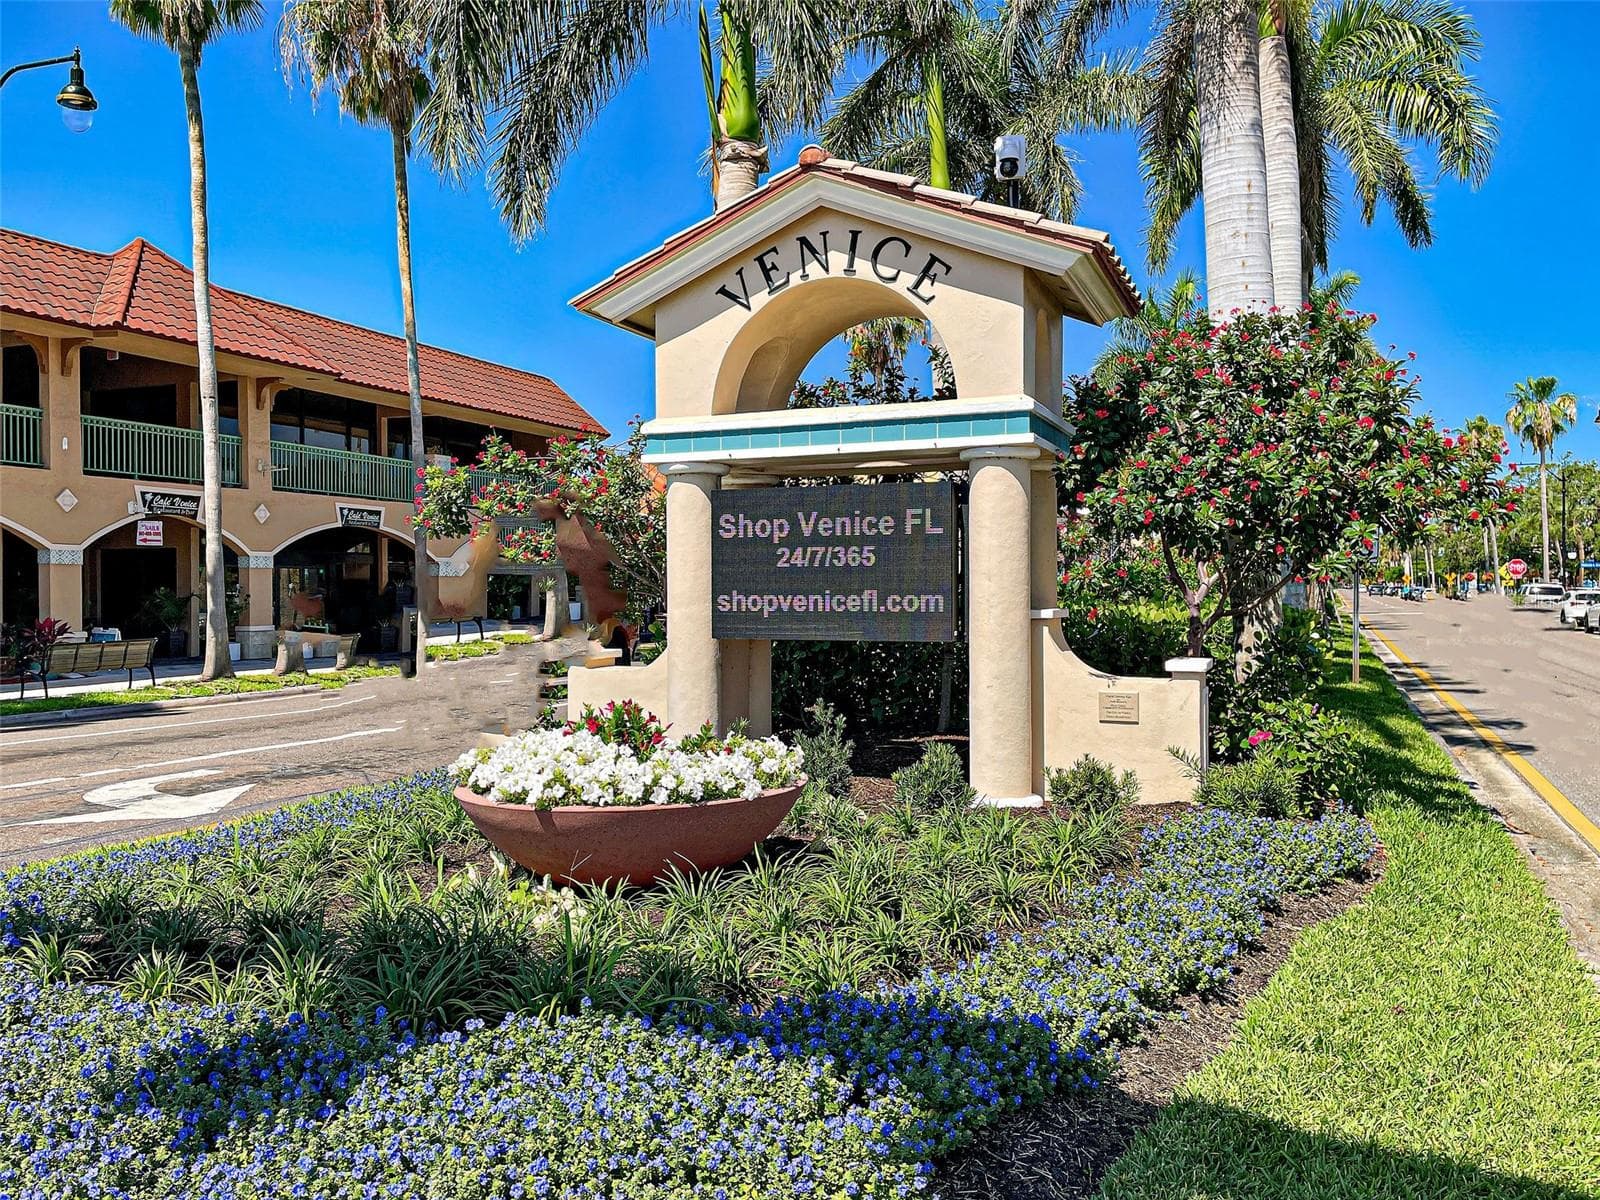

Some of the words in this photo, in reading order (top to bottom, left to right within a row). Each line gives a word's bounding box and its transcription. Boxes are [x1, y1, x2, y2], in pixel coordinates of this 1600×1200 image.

[715, 229, 952, 312] VENICE
[153, 494, 172, 510] Café
[173, 497, 198, 508] Venice
[718, 513, 790, 543] Shop
[797, 510, 896, 537] Venice
[904, 508, 944, 535] FL
[776, 545, 876, 567] 24/7/365
[1509, 563, 1525, 572] STOP
[716, 589, 945, 617] shopvenicefl.com
